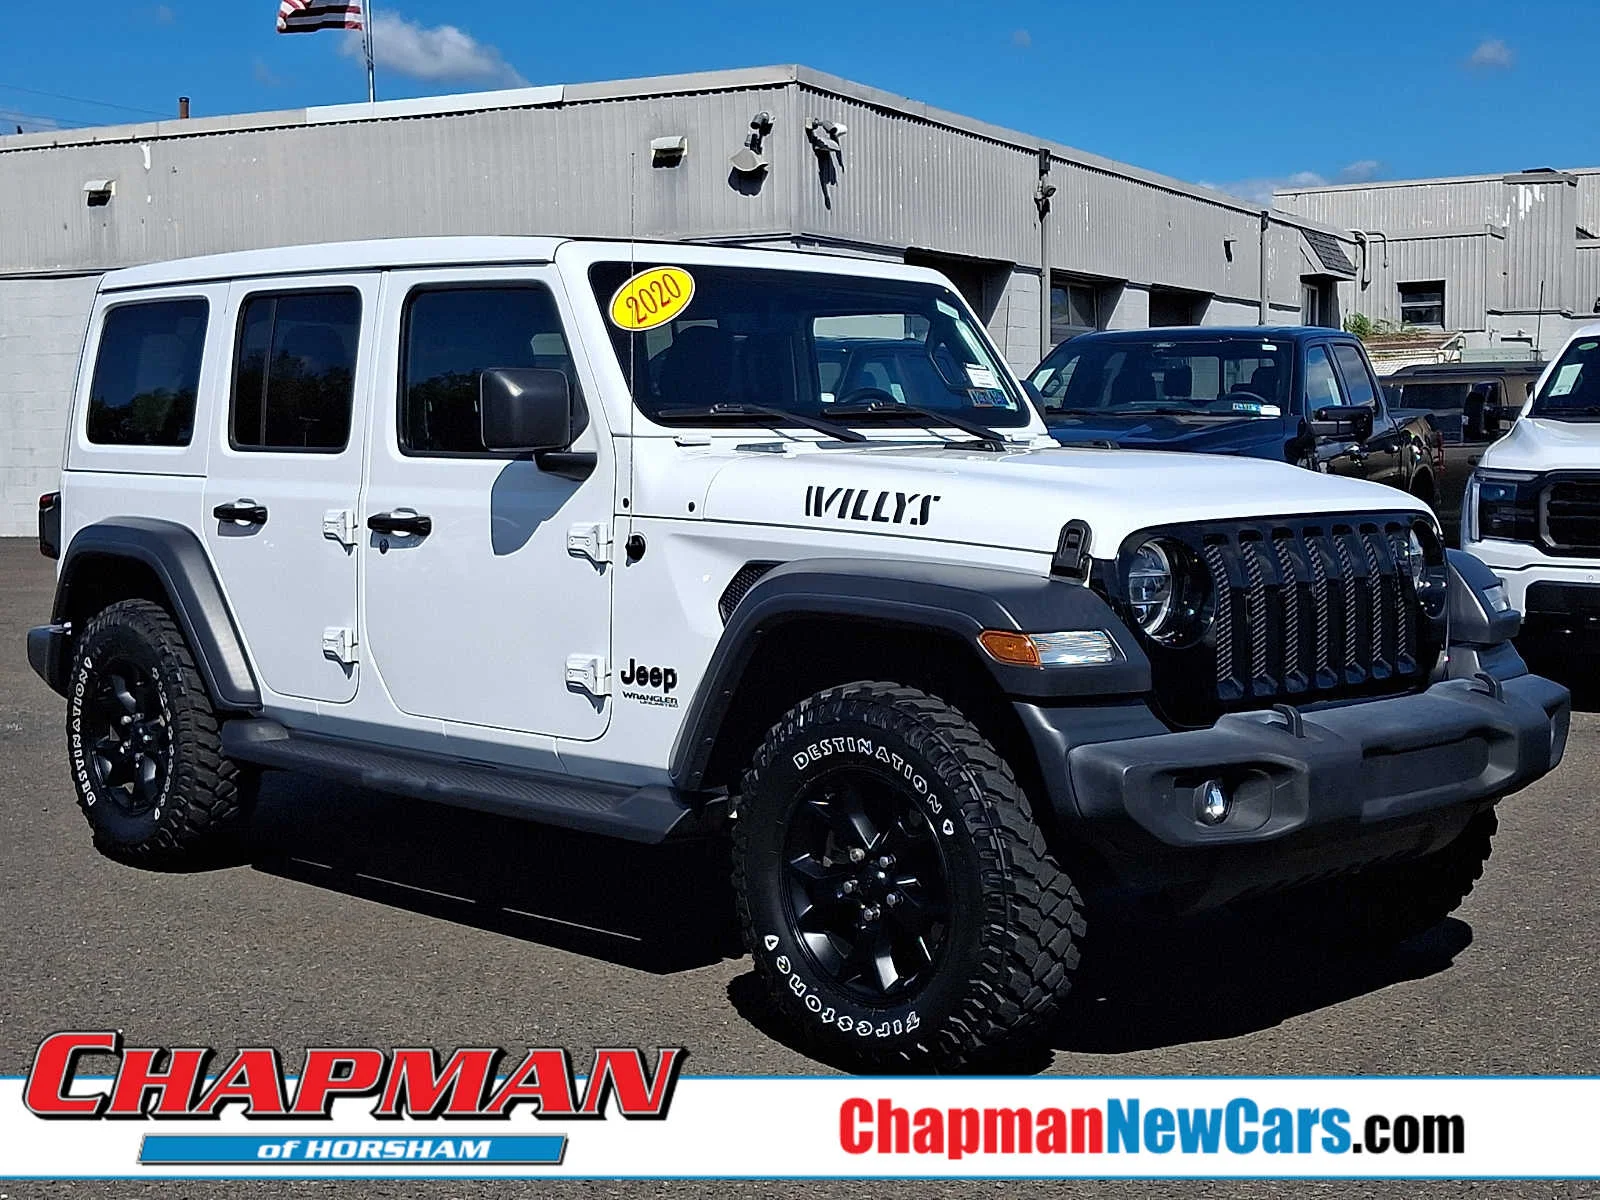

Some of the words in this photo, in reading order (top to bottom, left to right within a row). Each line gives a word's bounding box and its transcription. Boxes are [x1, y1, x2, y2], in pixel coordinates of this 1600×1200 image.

[626, 273, 681, 324] 2020
[805, 485, 942, 526] WILLYS
[620, 658, 678, 694] Jeep
[622, 691, 678, 705] WRANGLER
[72, 668, 97, 806] DESTINATION
[793, 737, 943, 814] DESTINATION
